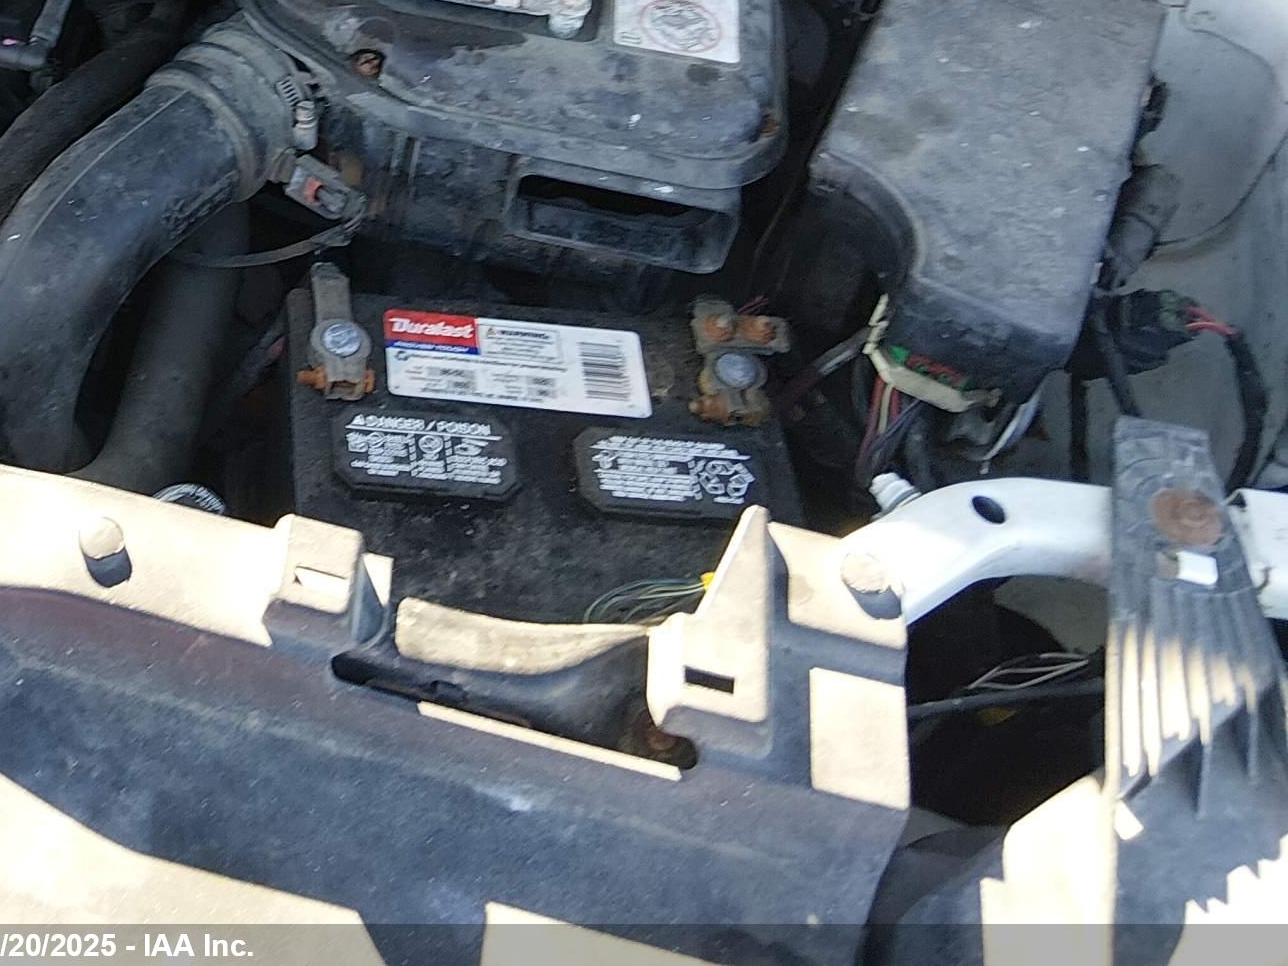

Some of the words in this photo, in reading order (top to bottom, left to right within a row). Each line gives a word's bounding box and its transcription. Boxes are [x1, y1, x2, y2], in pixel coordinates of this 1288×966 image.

[387, 316, 474, 340] Duralast
[365, 414, 425, 431] DANGER
[436, 421, 491, 436] POISON
